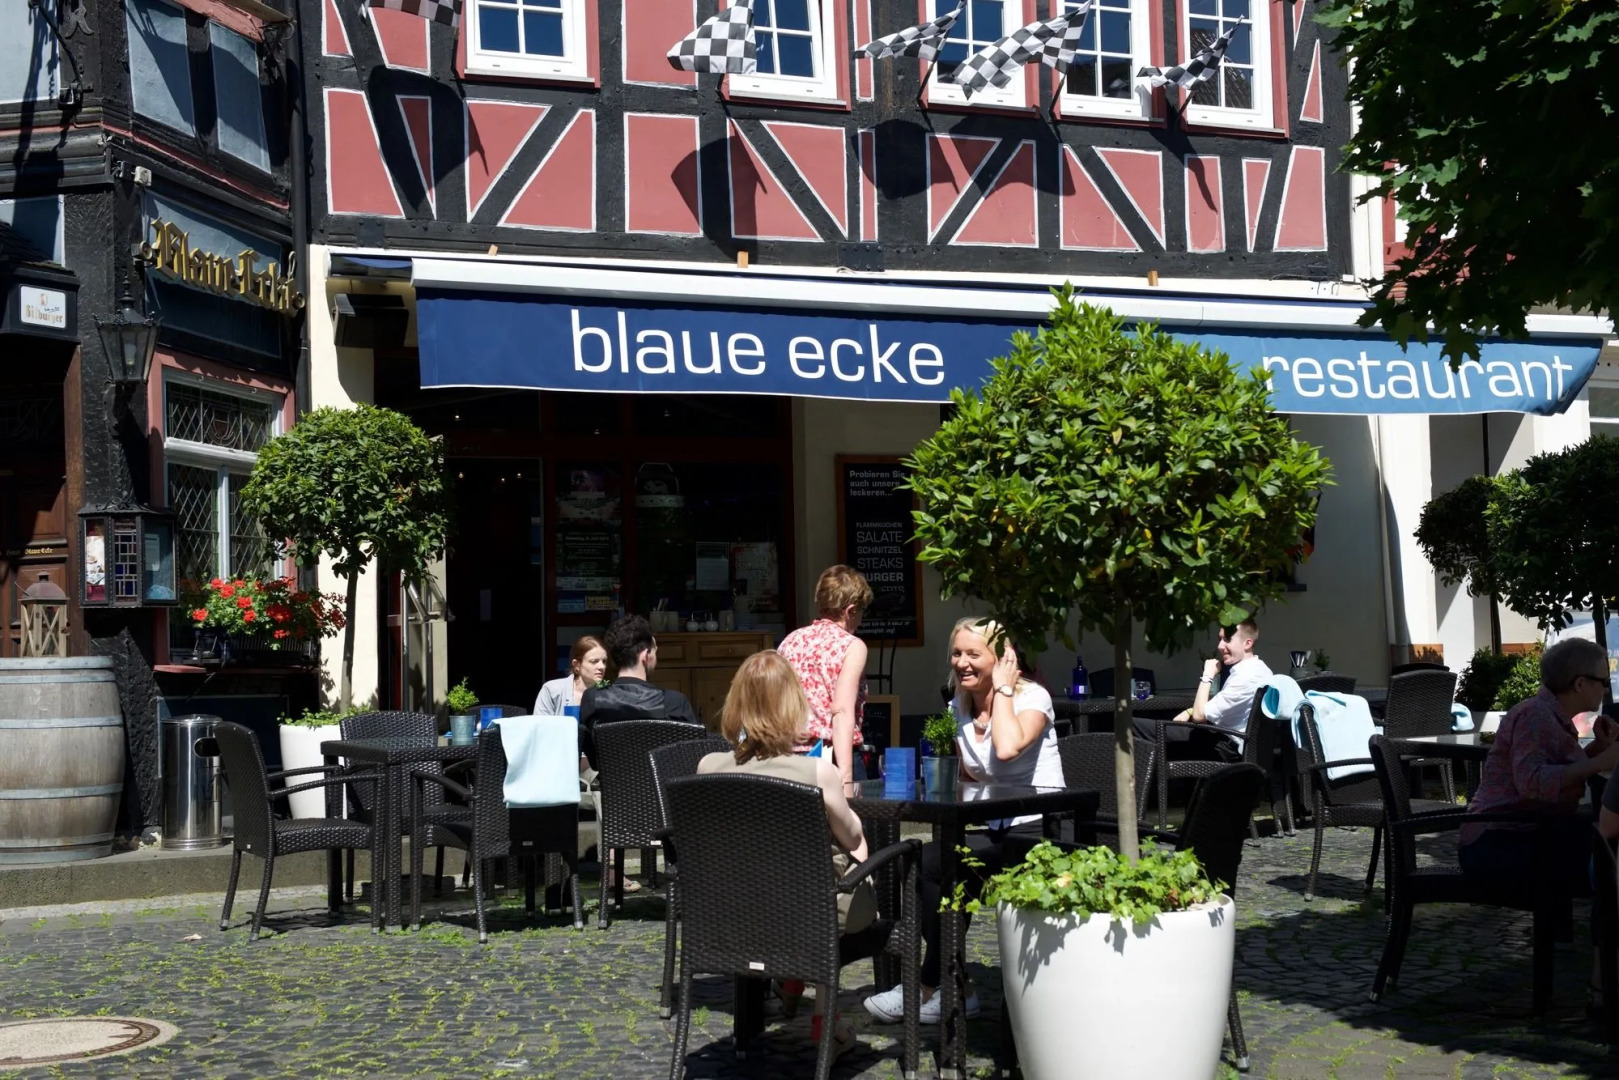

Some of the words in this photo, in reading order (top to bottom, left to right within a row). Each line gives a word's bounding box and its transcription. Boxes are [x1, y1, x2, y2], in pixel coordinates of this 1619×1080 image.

[571, 309, 767, 375] blaue
[788, 324, 945, 386] ecke
[1263, 352, 1573, 401] restaurant
[849, 470, 890, 478] Probieren
[850, 479, 869, 487] auch
[856, 531, 903, 543] SALATE
[856, 546, 903, 554] SCHNITZEL
[857, 557, 904, 569] STEAKS
